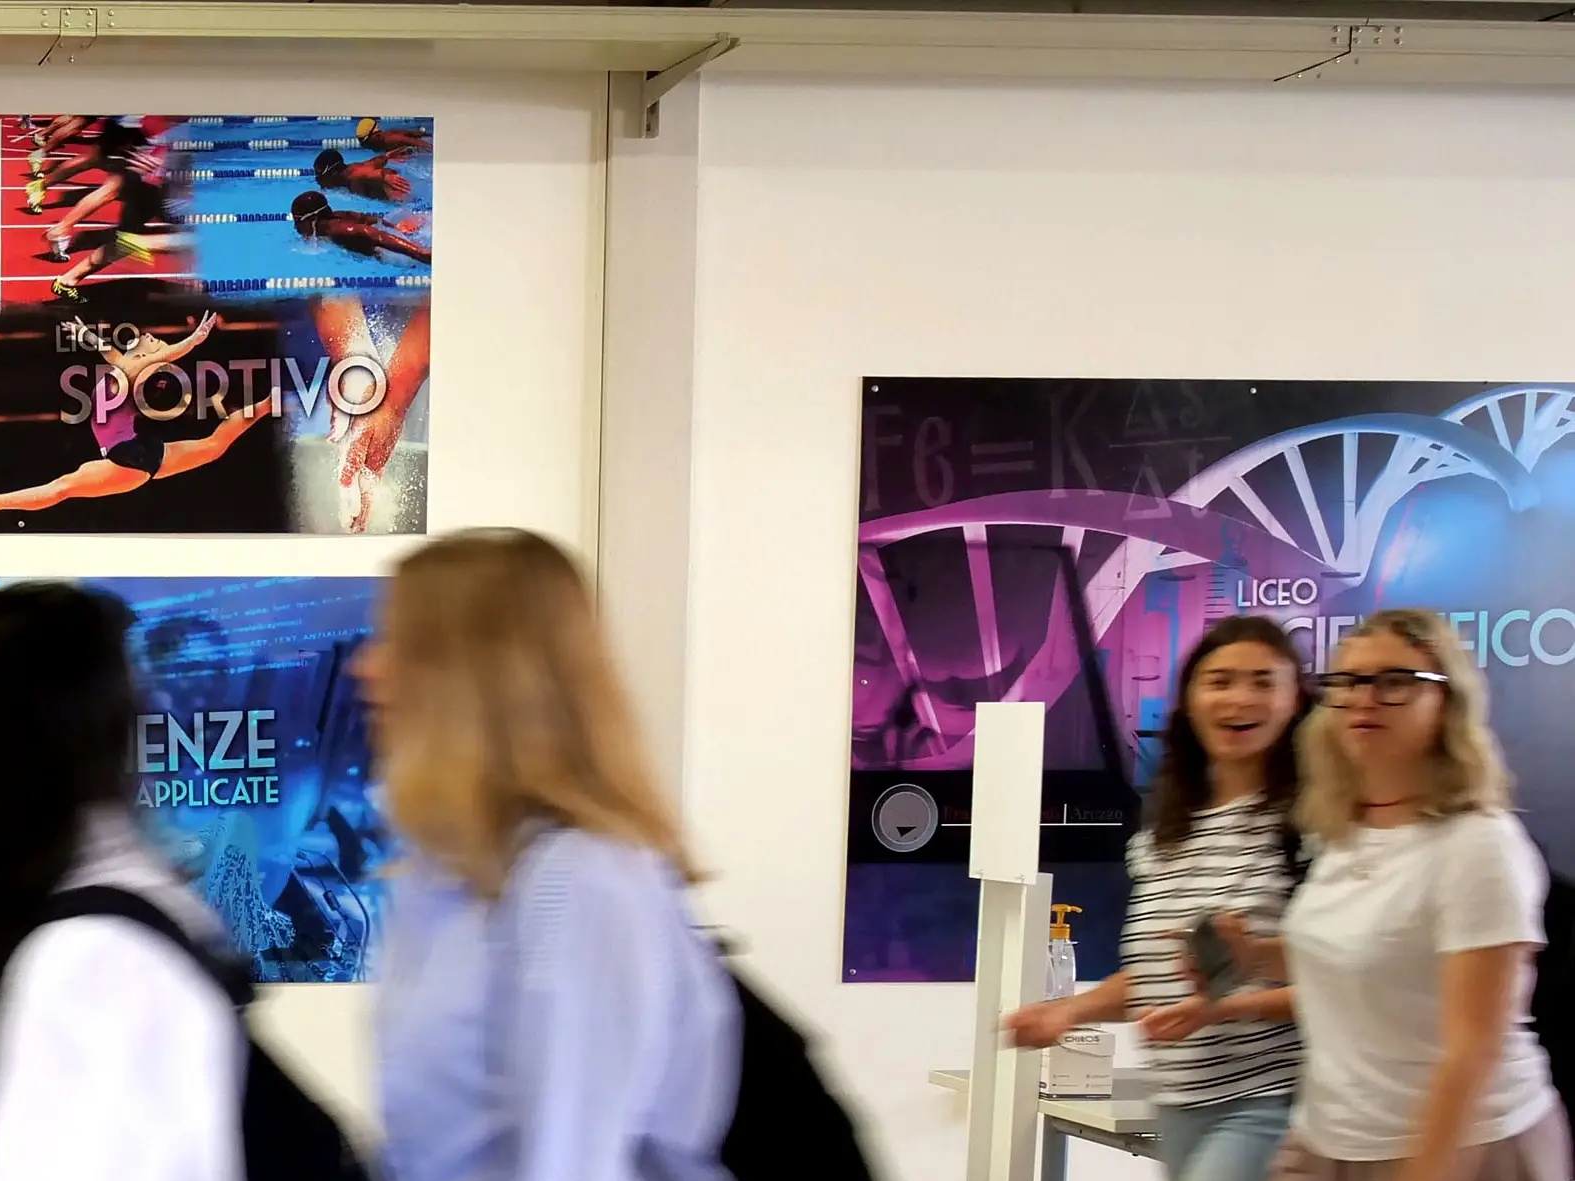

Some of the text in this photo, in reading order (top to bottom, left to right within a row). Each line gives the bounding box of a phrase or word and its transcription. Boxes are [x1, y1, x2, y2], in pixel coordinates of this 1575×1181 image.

[56, 322, 141, 353] LICEO
[59, 355, 387, 425] SPORTIVO
[1237, 577, 1318, 607] LICEO
[135, 709, 276, 773] ENZE
[135, 775, 279, 808] APPLICATE
